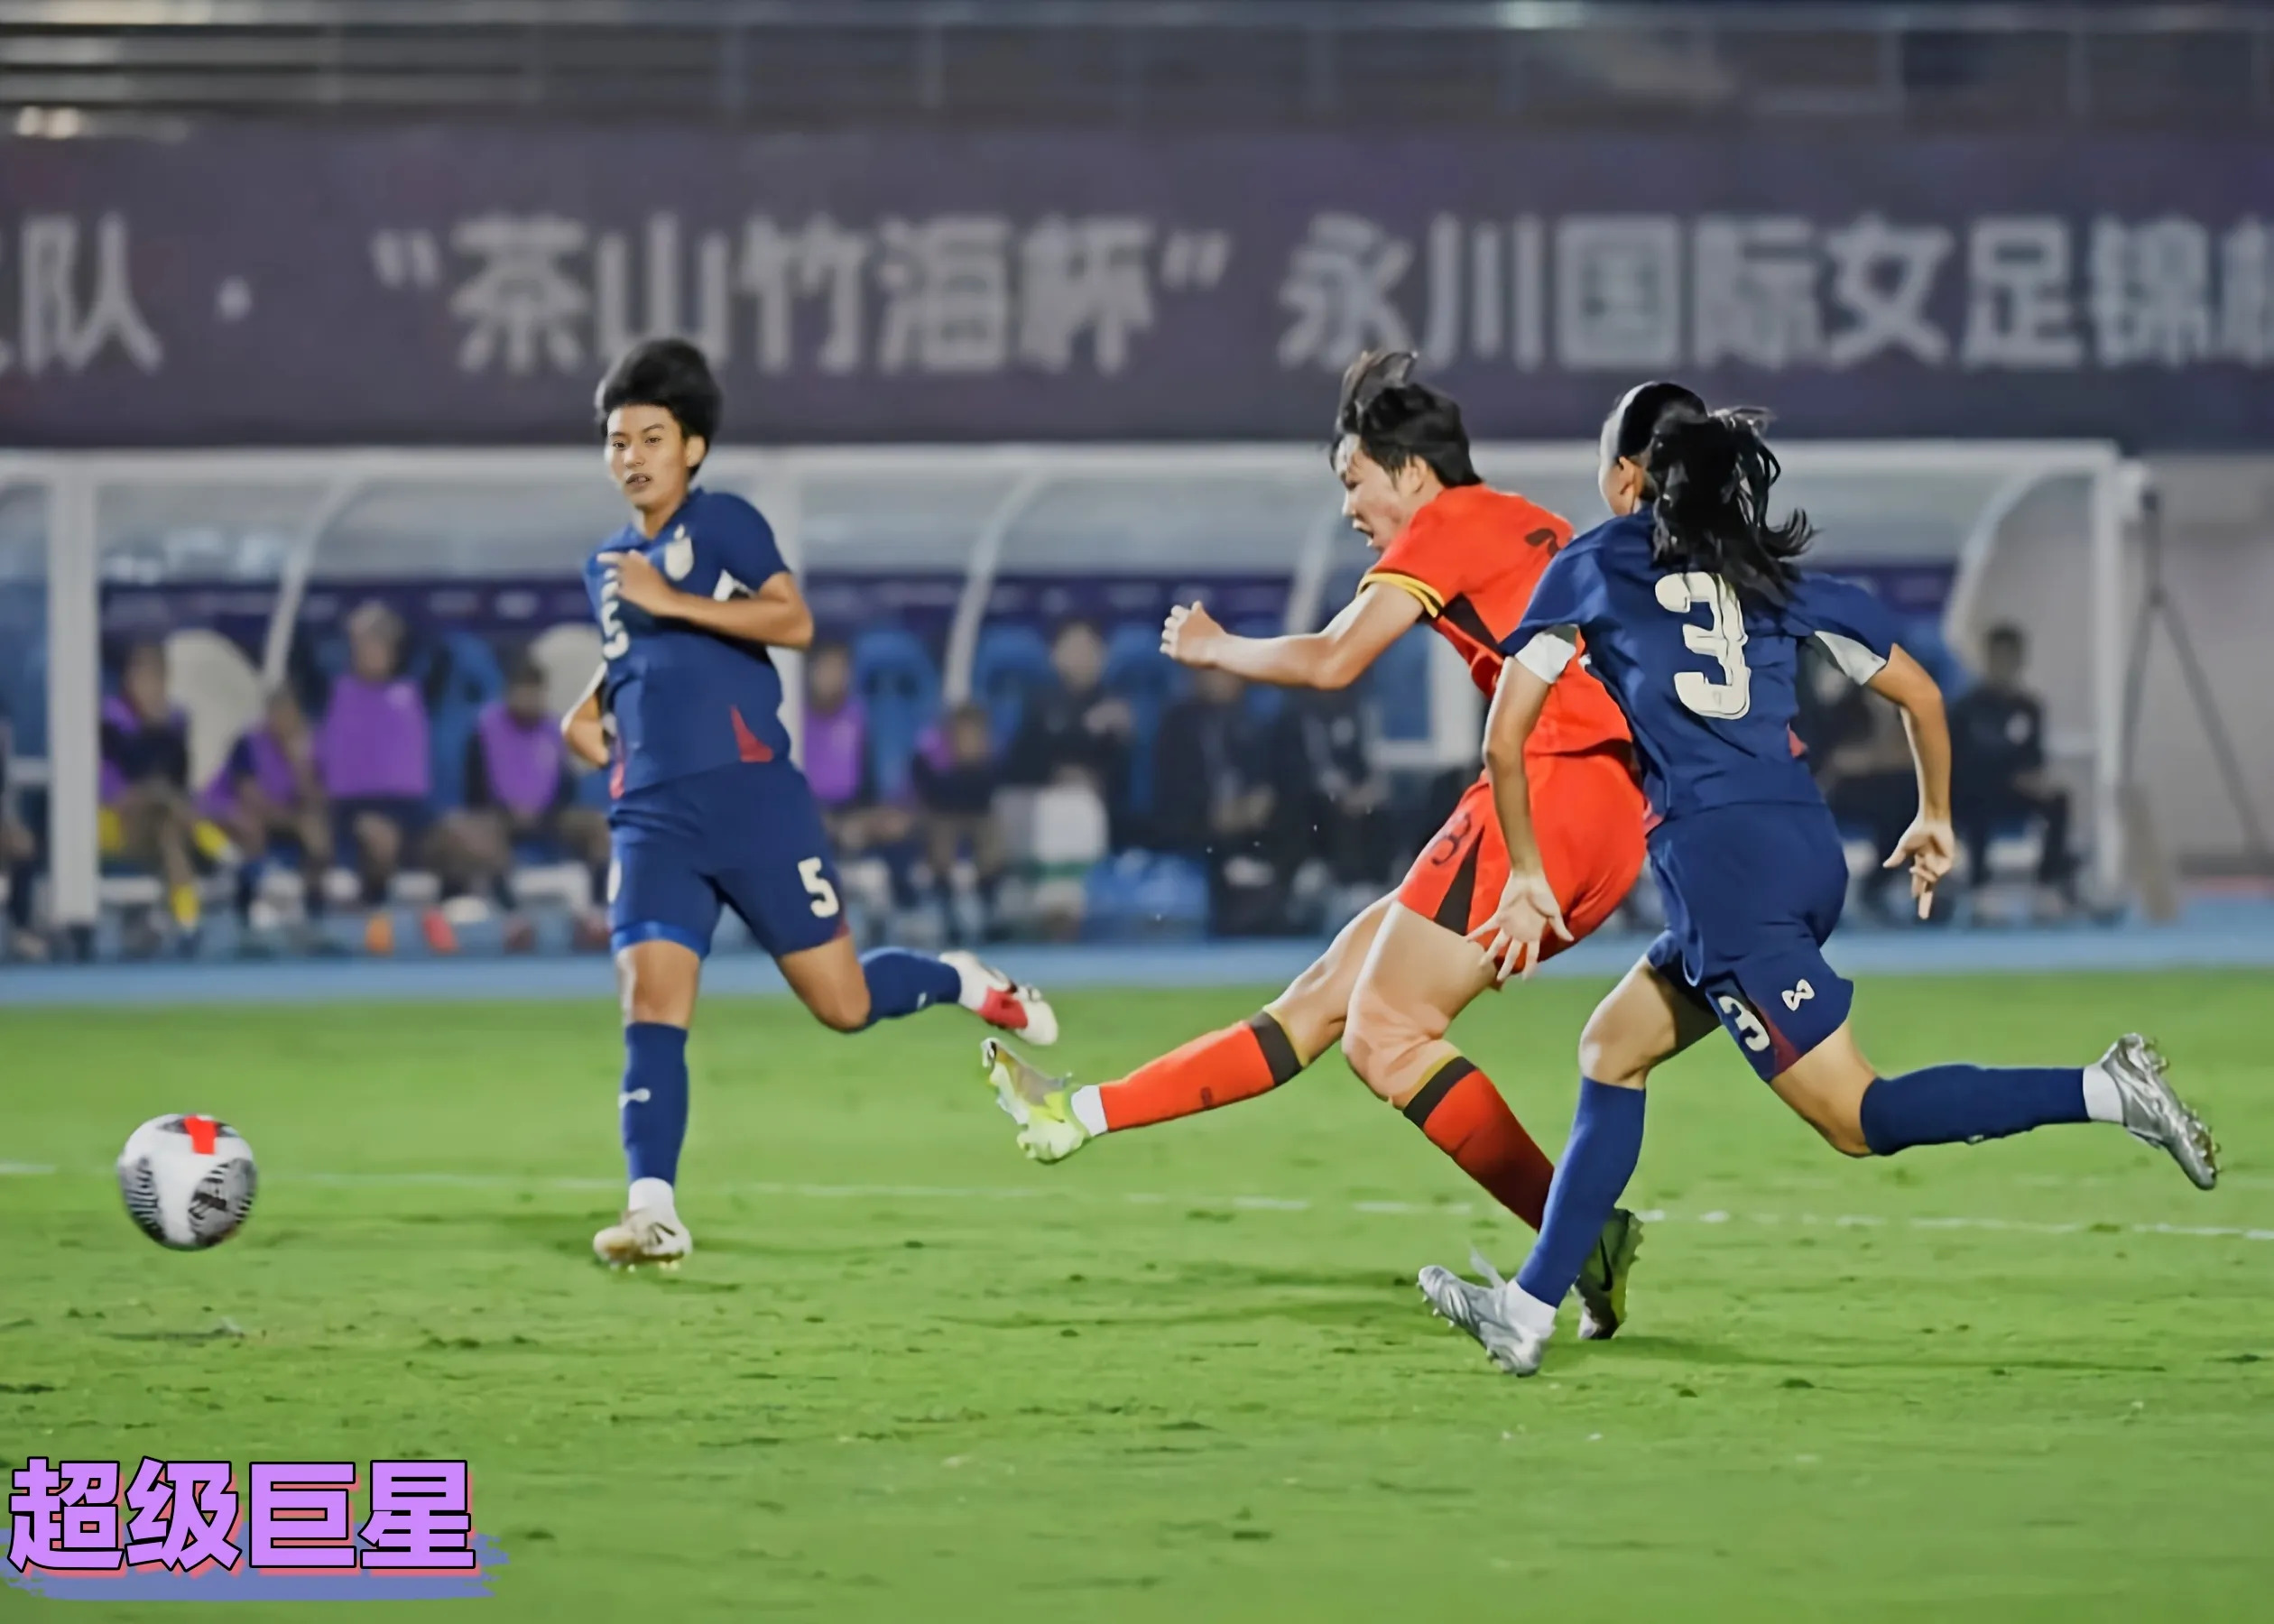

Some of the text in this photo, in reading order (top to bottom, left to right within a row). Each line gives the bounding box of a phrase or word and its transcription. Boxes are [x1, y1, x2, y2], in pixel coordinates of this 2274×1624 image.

[601, 601, 630, 660] 5
[1655, 571, 1752, 720] 3
[798, 856, 839, 918] 5
[1717, 995, 1770, 1052] 3
